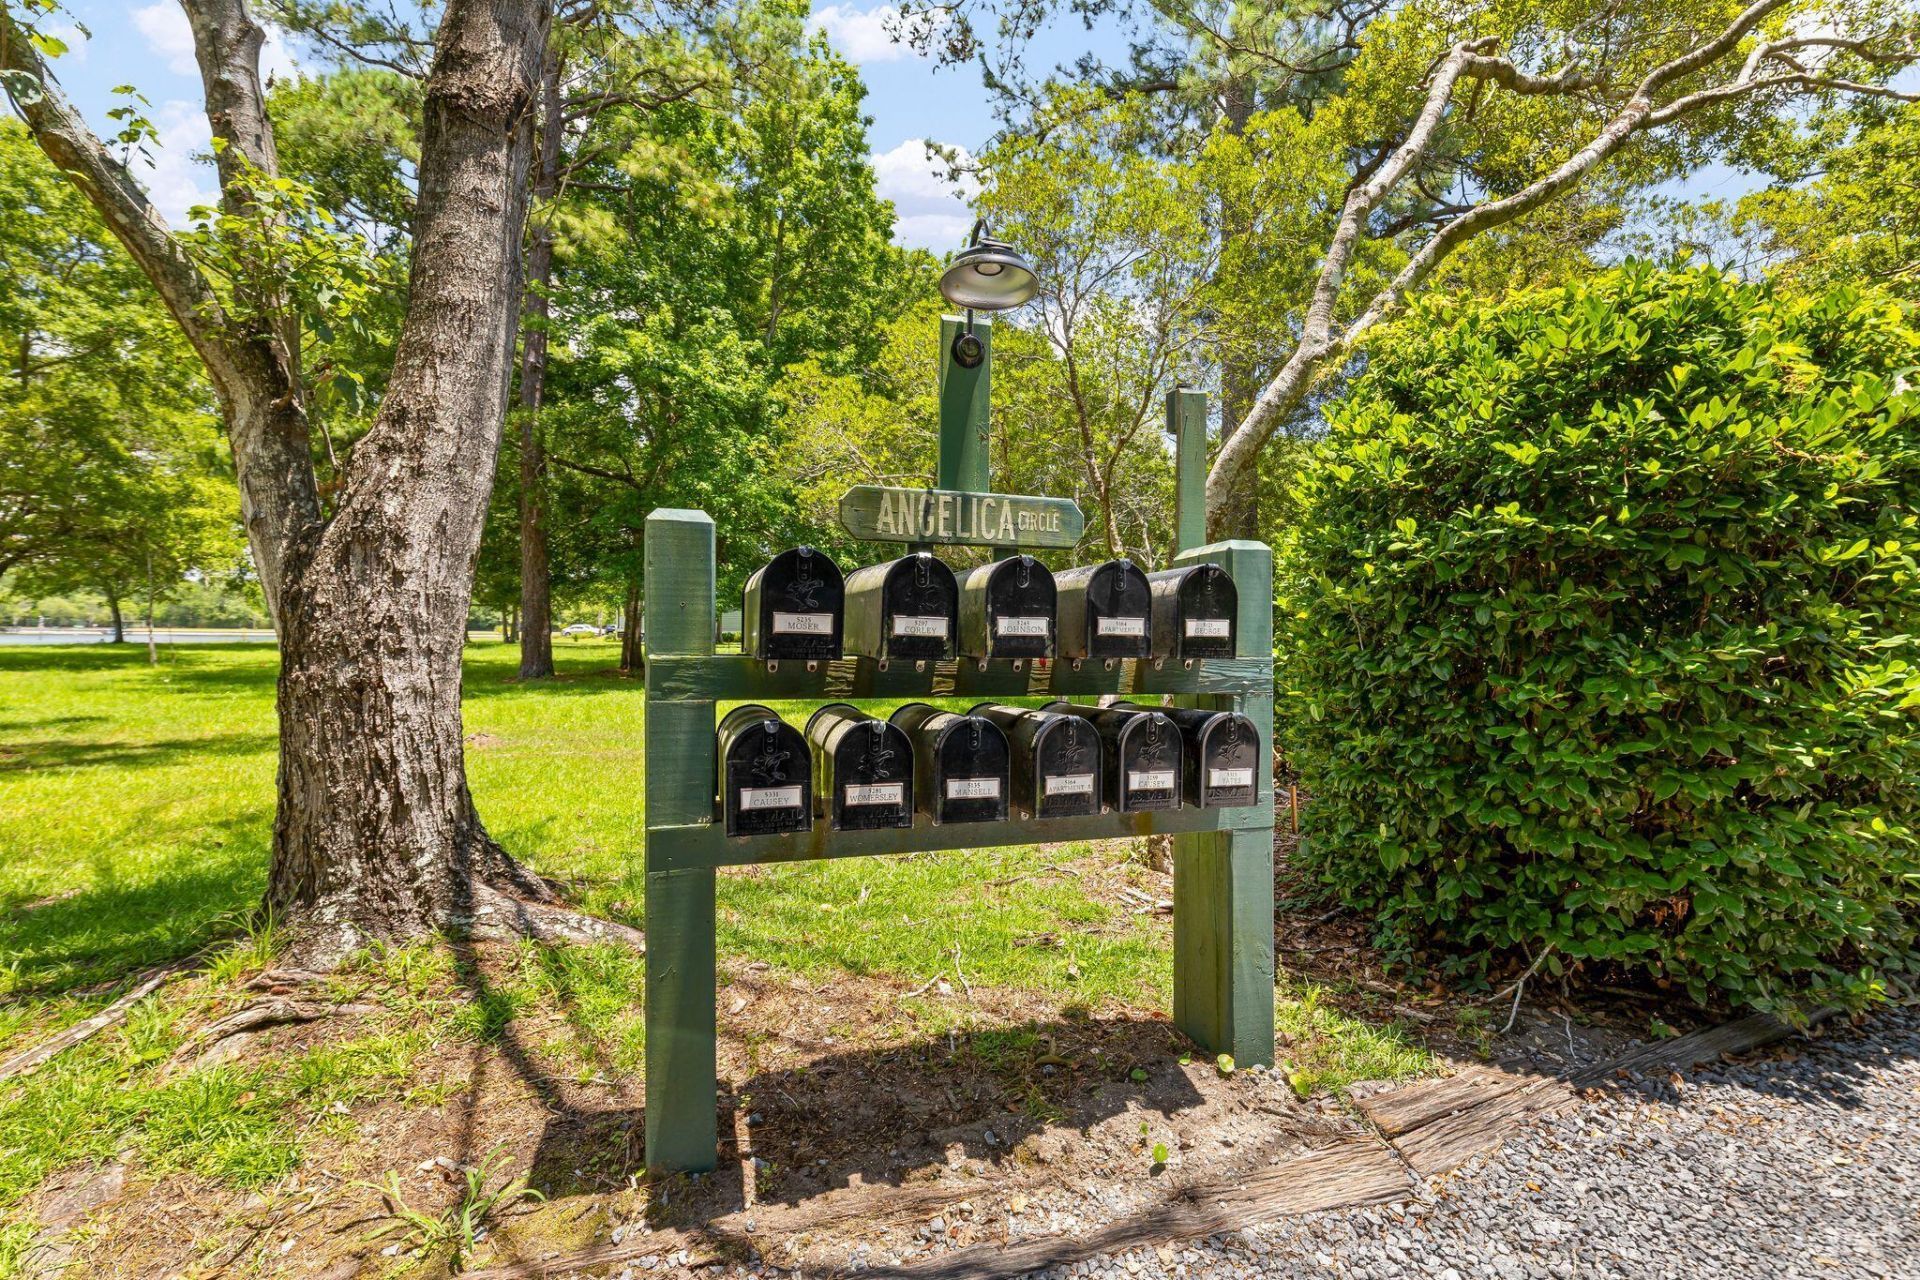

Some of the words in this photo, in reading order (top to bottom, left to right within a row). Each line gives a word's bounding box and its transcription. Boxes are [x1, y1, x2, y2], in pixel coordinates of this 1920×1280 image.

[876, 492, 1016, 541] ANGELICA
[1017, 510, 1060, 533] CIRCLE
[787, 622, 819, 631] MOSER
[904, 625, 937, 634] CORLEY
[1194, 627, 1222, 635] GEORGE
[1138, 780, 1165, 788] CAUSEY
[1221, 777, 1241, 785] YATES
[955, 788, 993, 796] MANSELL
[1048, 784, 1084, 793] APARTMENT
[753, 797, 789, 806] CAUSEY
[849, 793, 897, 802] WOMERSLEY
